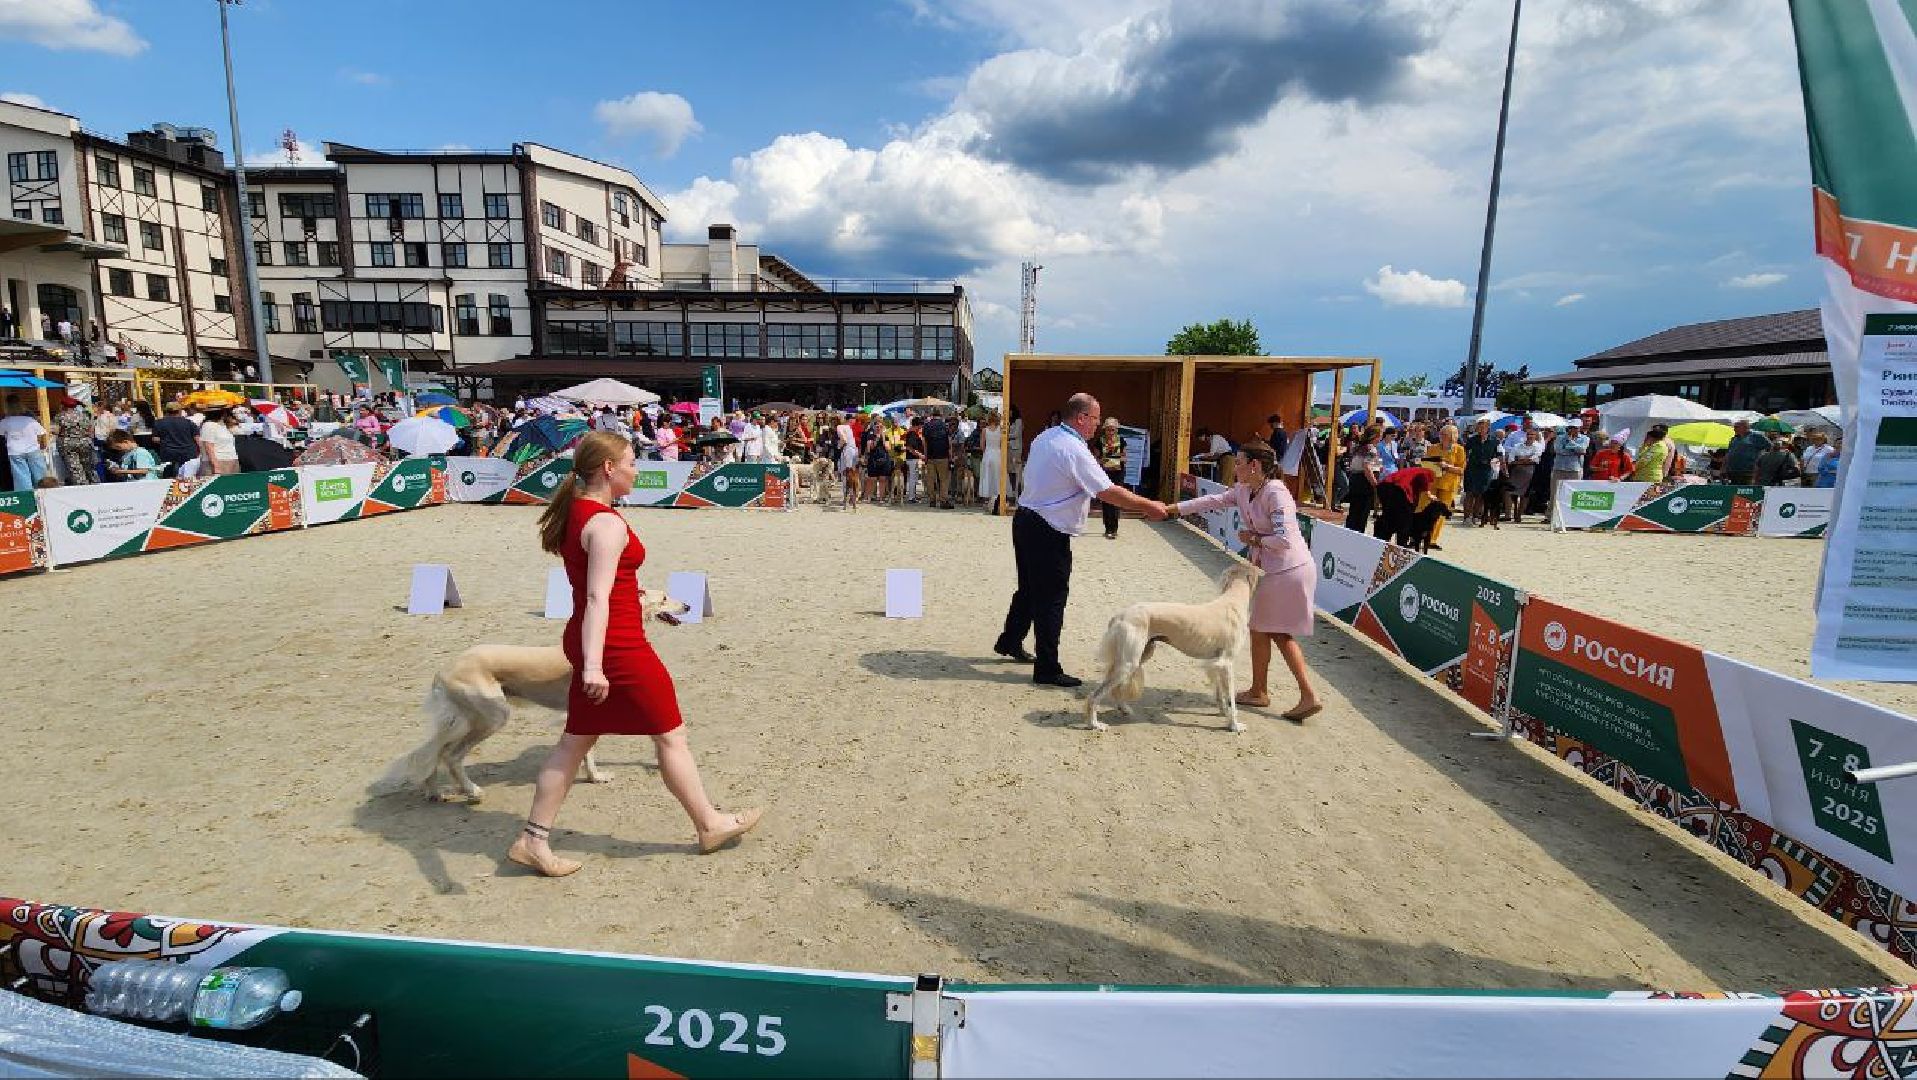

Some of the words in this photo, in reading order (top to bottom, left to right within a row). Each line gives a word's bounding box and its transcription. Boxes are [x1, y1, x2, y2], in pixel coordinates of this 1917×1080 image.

[1421, 593, 1460, 622] РОССИЯ
[1477, 585, 1501, 606] 2025
[1573, 634, 1675, 690] РОССИЯ
[1809, 738, 1825, 758] 7
[1842, 753, 1861, 773] 8
[1811, 767, 1870, 803] ИЮНЯ
[1821, 796, 1879, 835] 2025
[643, 1004, 788, 1057] 2025
